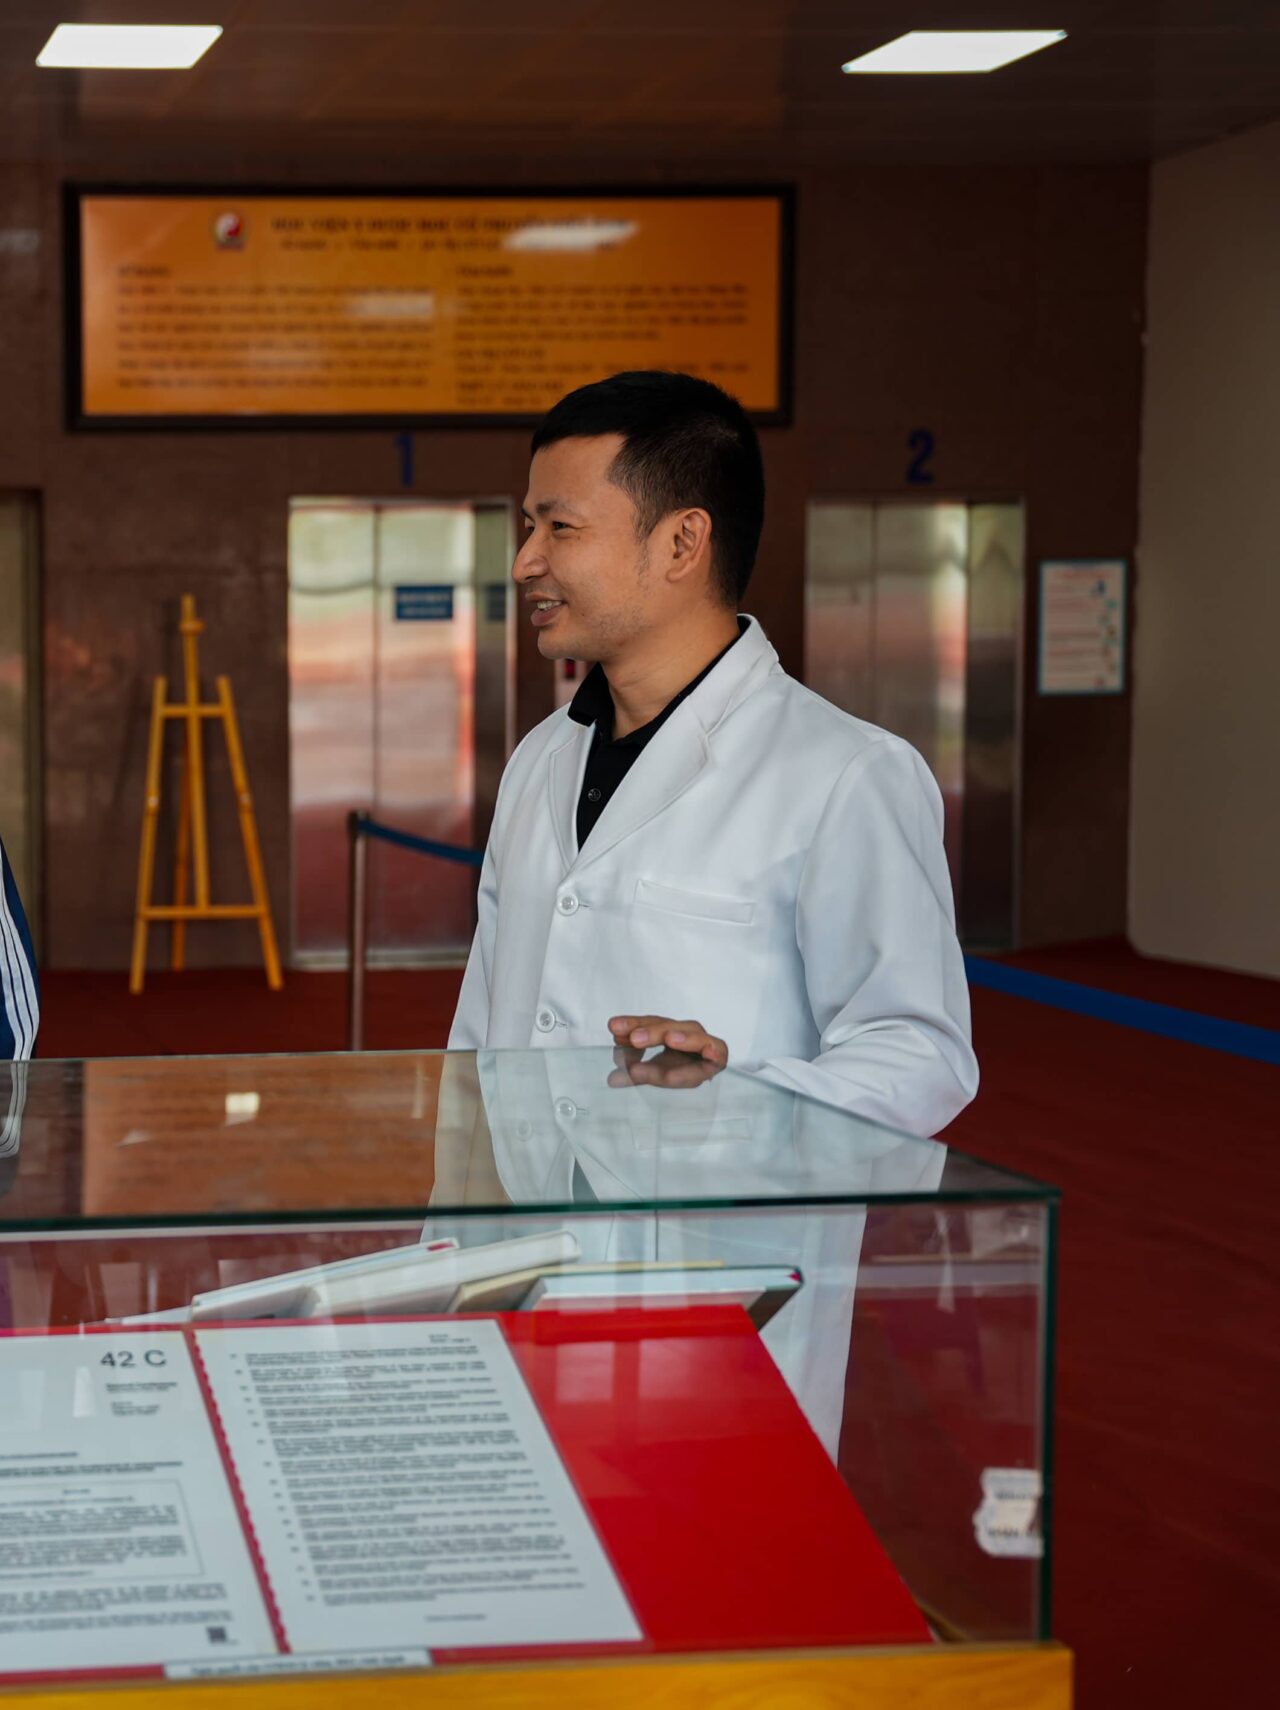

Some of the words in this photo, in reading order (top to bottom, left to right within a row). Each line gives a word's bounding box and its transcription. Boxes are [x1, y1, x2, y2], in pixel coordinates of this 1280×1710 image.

[393, 434, 416, 487] 1
[907, 429, 934, 484] 2
[100, 1349, 137, 1367] 42
[144, 1349, 167, 1367] C
